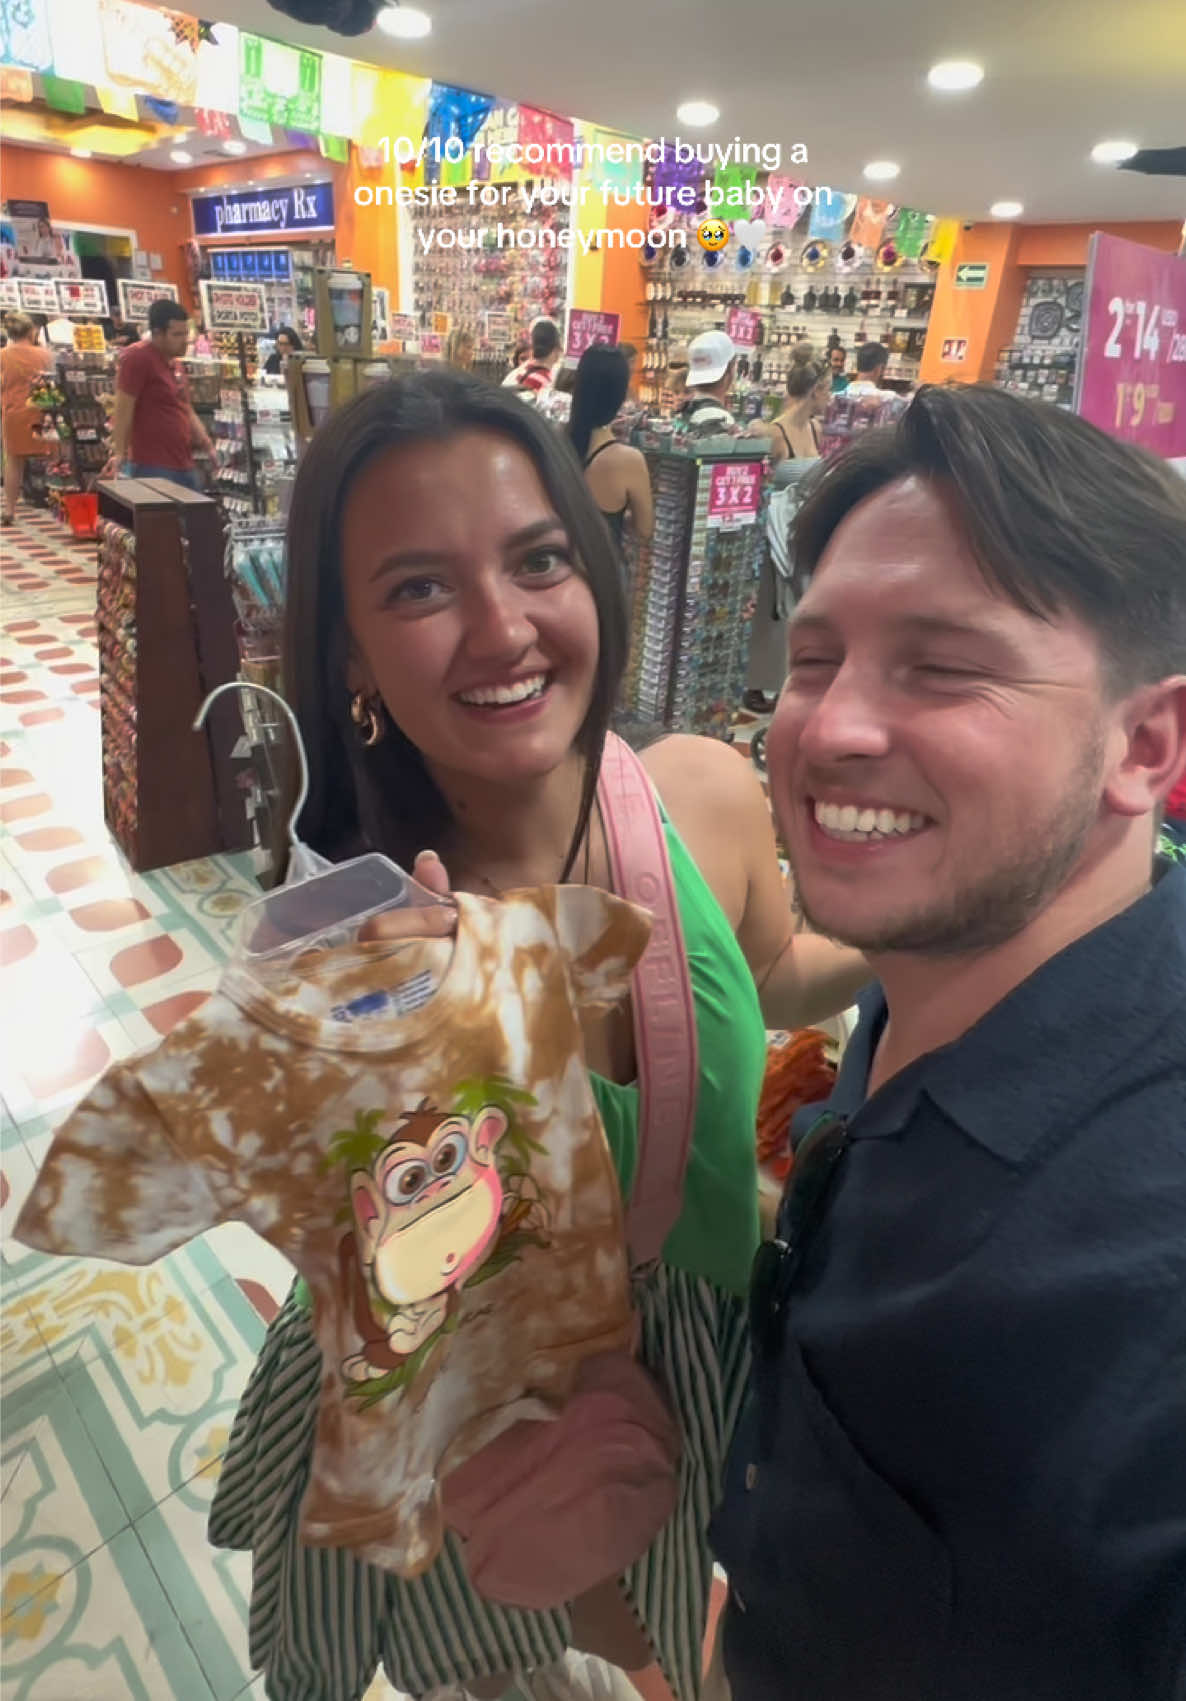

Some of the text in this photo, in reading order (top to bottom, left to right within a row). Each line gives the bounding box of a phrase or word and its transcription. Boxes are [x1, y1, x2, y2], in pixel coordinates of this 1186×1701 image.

[215, 187, 317, 233] pharmacy Rx
[572, 331, 582, 349] 3
[1104, 297, 1125, 358] 2
[1133, 301, 1160, 361] 14
[715, 485, 753, 506] 3 X 2
